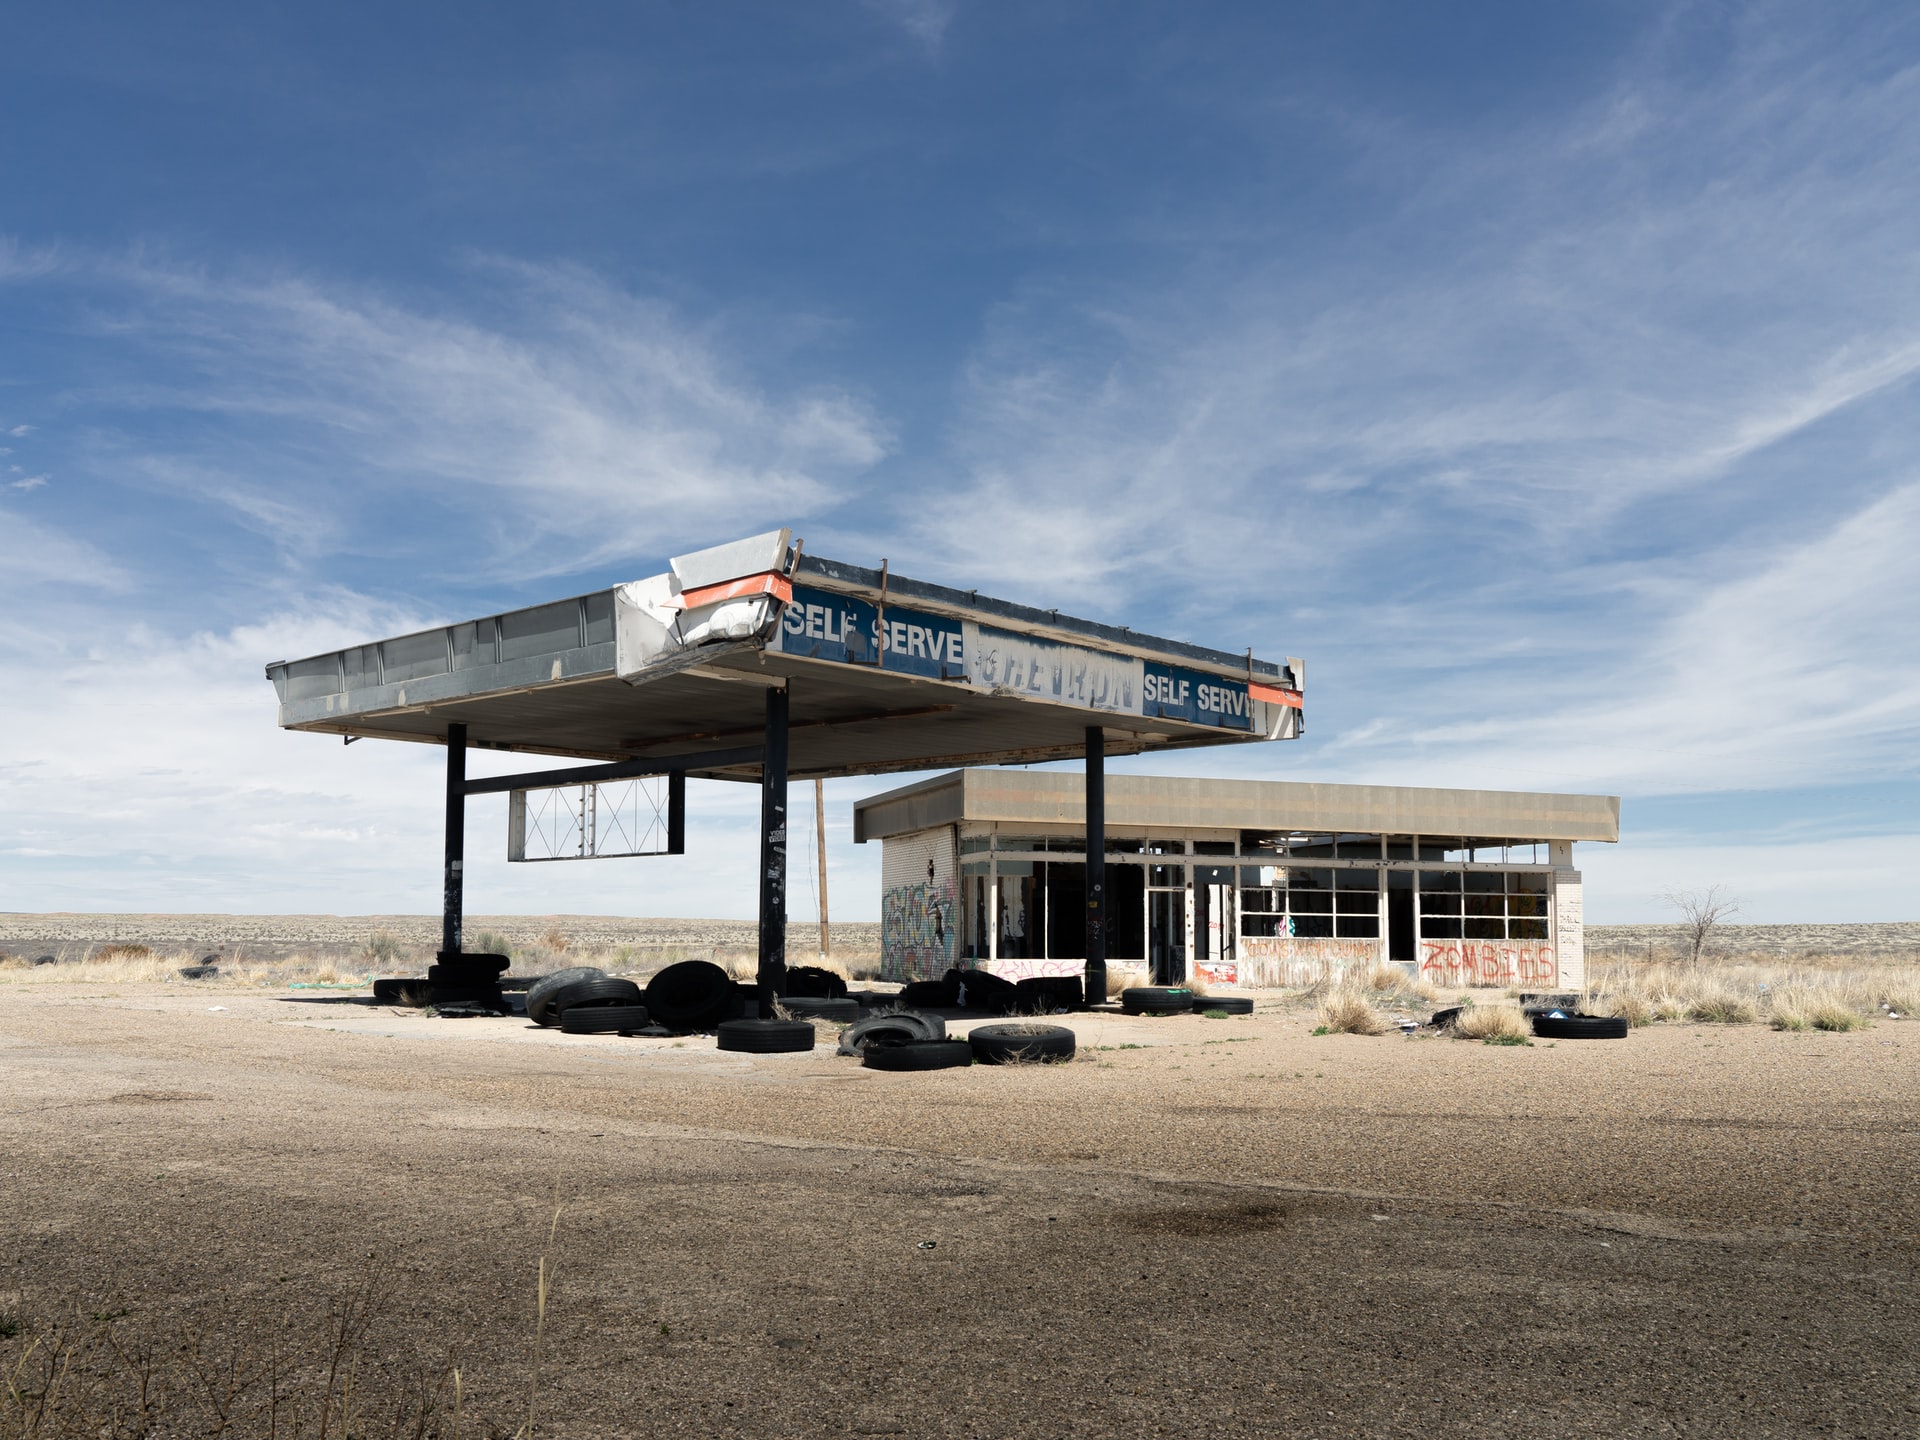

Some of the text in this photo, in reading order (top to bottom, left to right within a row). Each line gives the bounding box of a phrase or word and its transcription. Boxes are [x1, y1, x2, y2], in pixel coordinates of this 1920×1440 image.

[784, 601, 963, 664] SELF SERVE
[1143, 673, 1190, 706] SELF
[1422, 943, 1555, 980] ZOMBIES
